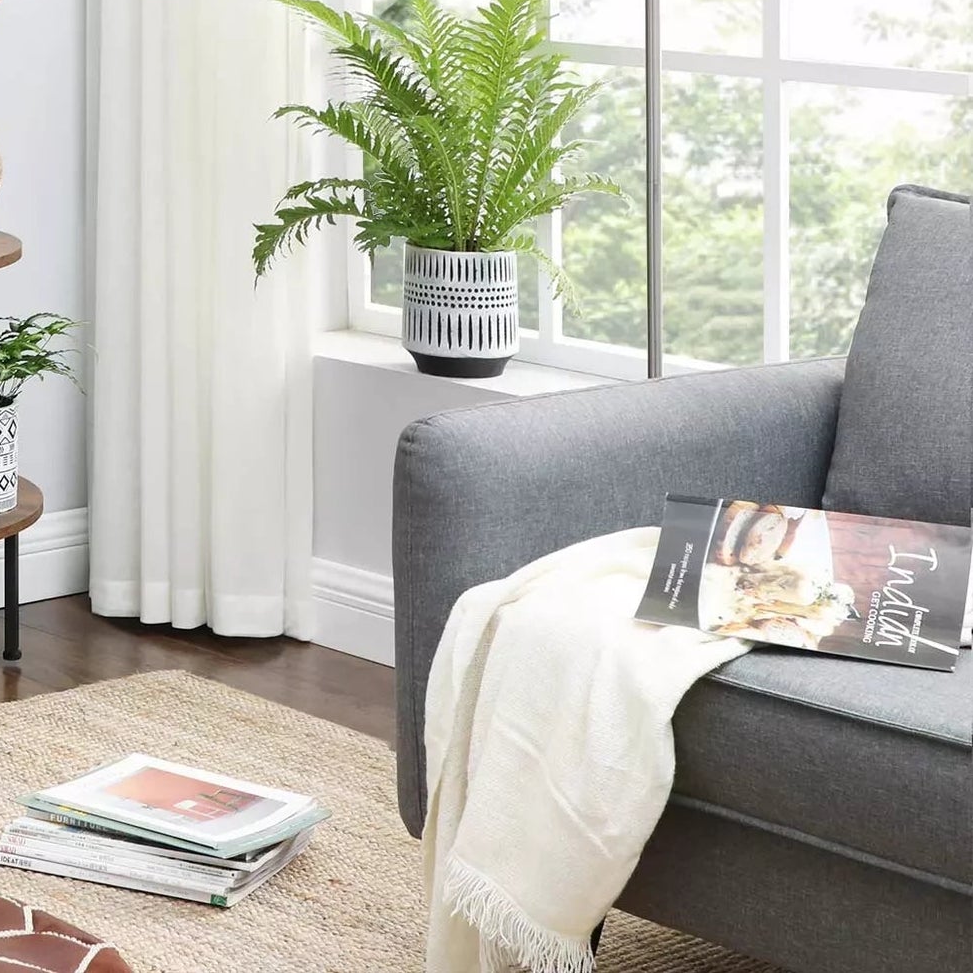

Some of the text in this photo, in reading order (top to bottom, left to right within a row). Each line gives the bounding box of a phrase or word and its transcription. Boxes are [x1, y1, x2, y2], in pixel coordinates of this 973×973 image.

[862, 591, 881, 644] GET COOKING
[874, 544, 960, 655] Indian
